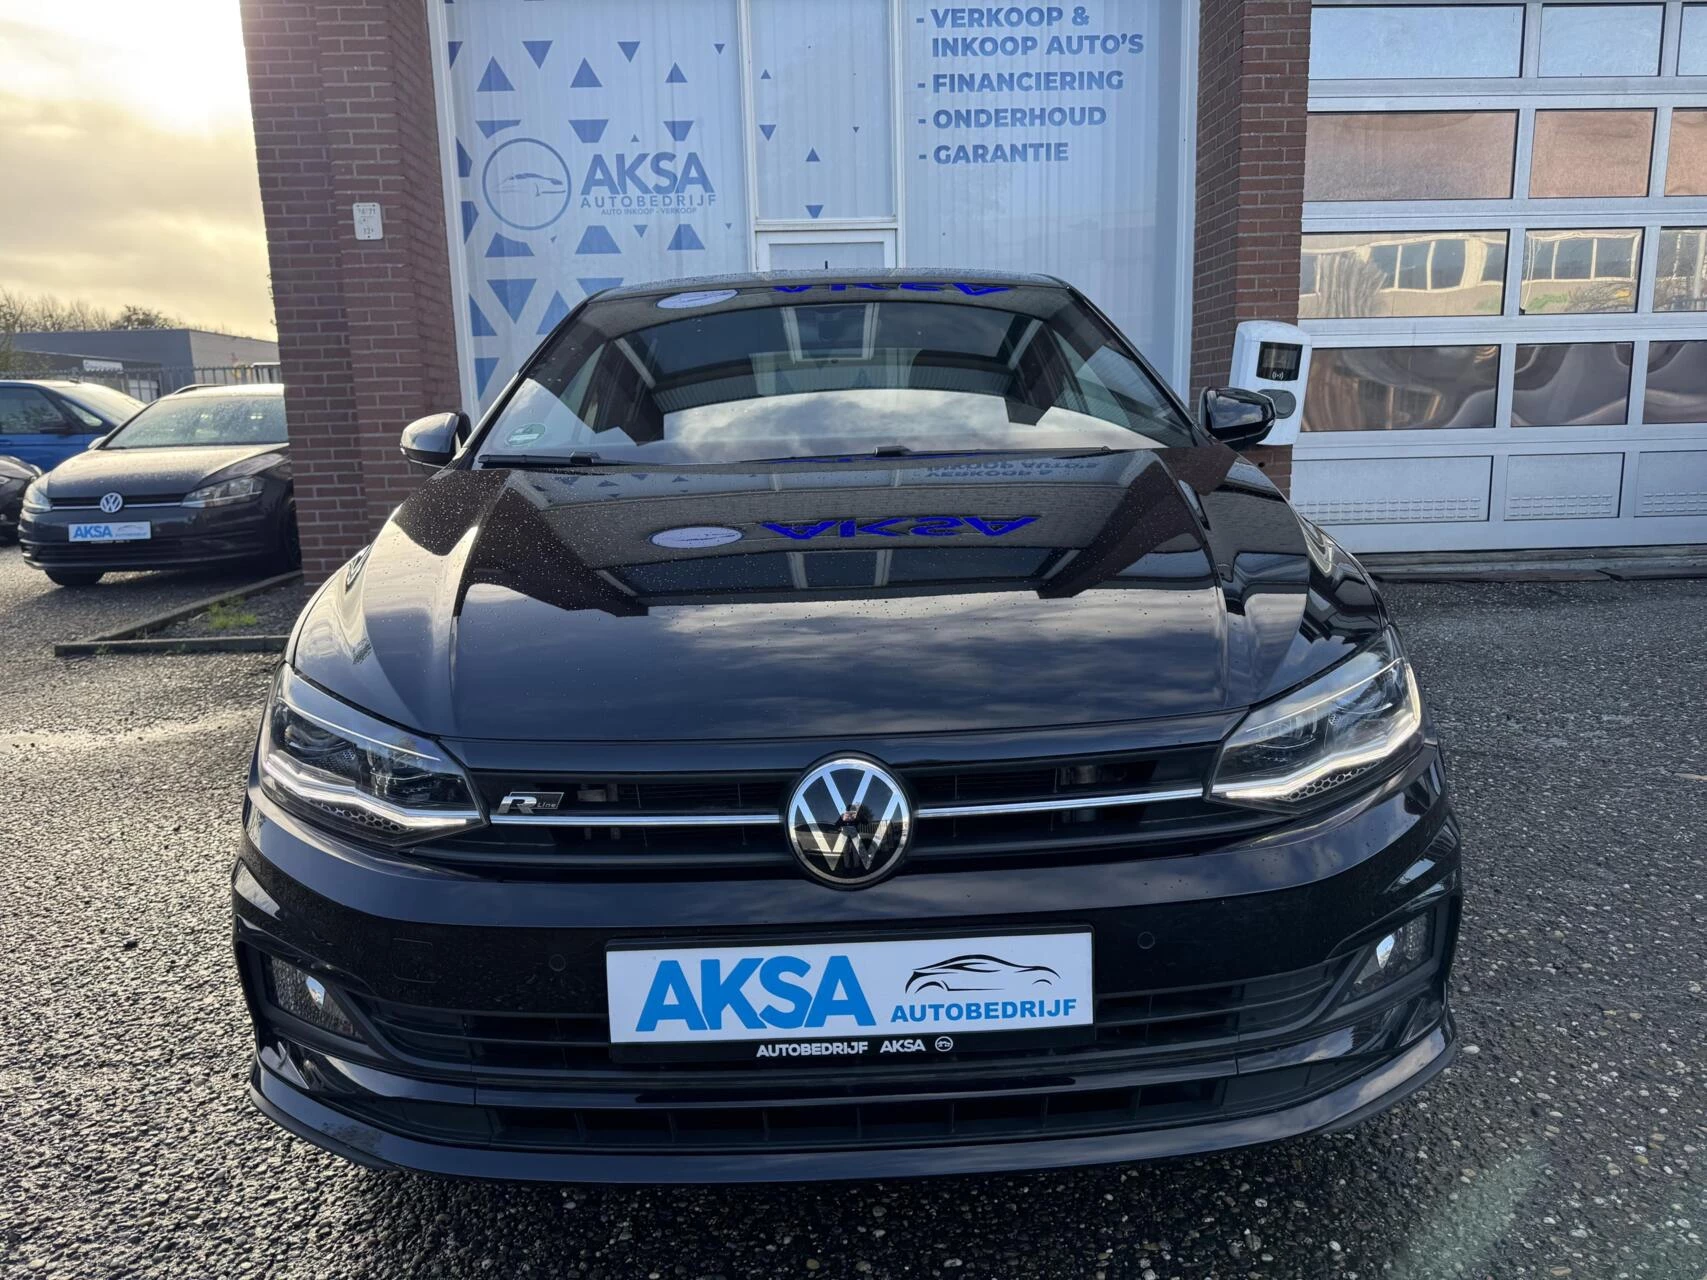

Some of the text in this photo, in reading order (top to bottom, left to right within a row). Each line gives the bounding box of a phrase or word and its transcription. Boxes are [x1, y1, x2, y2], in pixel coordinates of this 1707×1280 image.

[930, 7, 1064, 28] VERKOOP
[1071, 6, 1090, 26] &
[932, 33, 1144, 57] INKOOP AUTO'S
[932, 70, 1124, 93] FINANCIERING
[932, 106, 1107, 129] ONDERHOUD
[933, 142, 1069, 164] GARANTIE
[580, 151, 715, 196] AKSA
[580, 194, 717, 209] AUTOBEDRIJF
[601, 208, 622, 216] AUTO
[72, 525, 113, 539] AKSA
[496, 796, 537, 814] R
[634, 954, 1077, 1032] AKSA AUTOBEDRIJF
[756, 1039, 927, 1058] AUTOBEDRIJF AKSA
